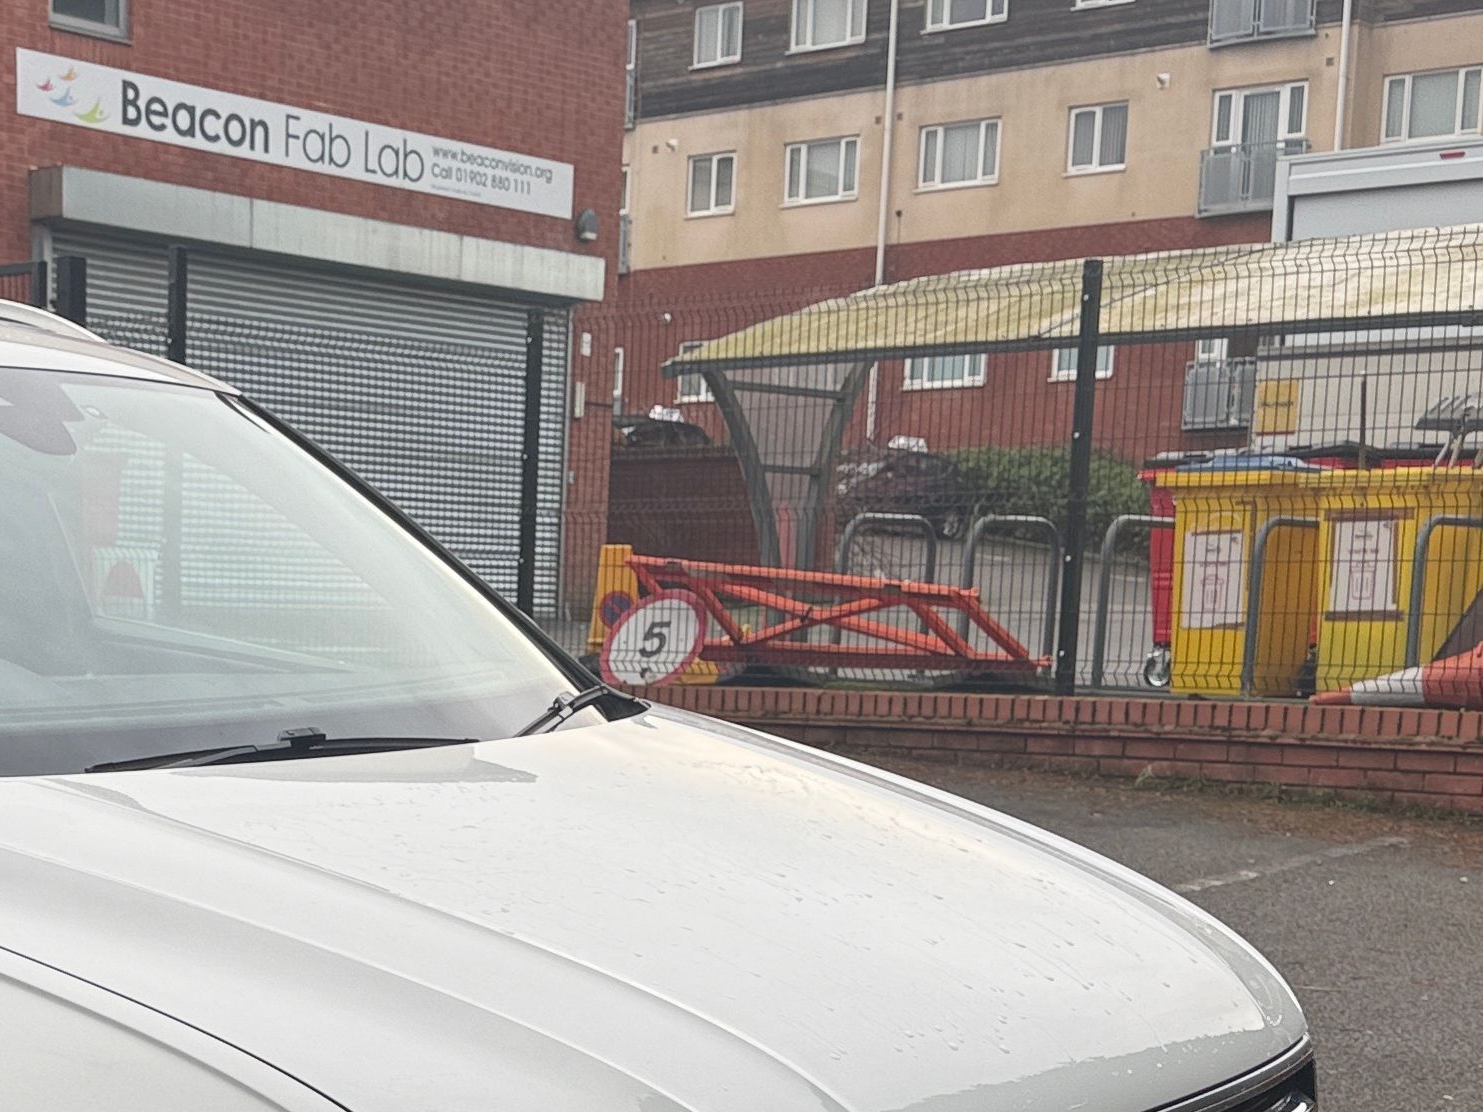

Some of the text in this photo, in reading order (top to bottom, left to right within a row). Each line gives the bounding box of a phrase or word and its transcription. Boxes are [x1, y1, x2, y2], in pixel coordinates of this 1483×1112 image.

[121, 79, 425, 183] Beacon Fab Lab
[431, 145, 554, 184] www.beaconvision.org
[431, 162, 453, 181] Call
[455, 167, 488, 188] 01902
[638, 620, 672, 659] 5
